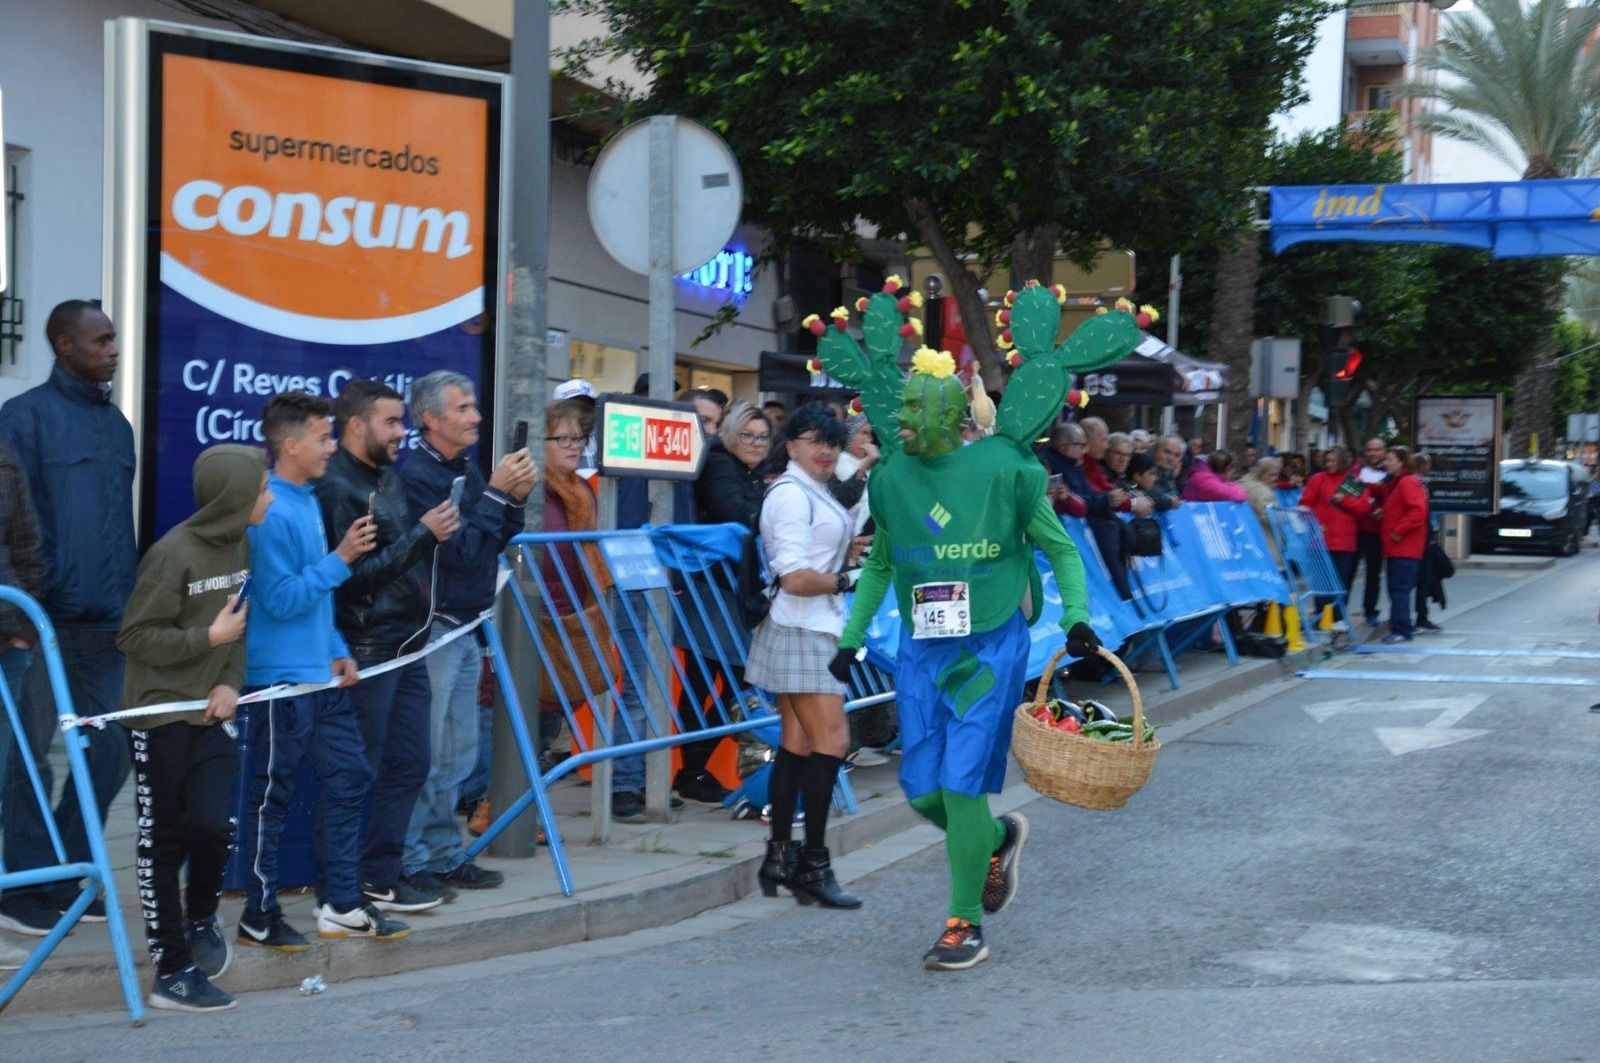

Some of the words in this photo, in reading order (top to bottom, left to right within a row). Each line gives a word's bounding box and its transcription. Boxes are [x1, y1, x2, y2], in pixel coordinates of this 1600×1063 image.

[229, 130, 440, 176] supermercados
[172, 179, 473, 259] consum
[182, 359, 226, 396] C/
[609, 420, 641, 452] E-15
[646, 424, 690, 456] N-340
[924, 609, 945, 625] 145
